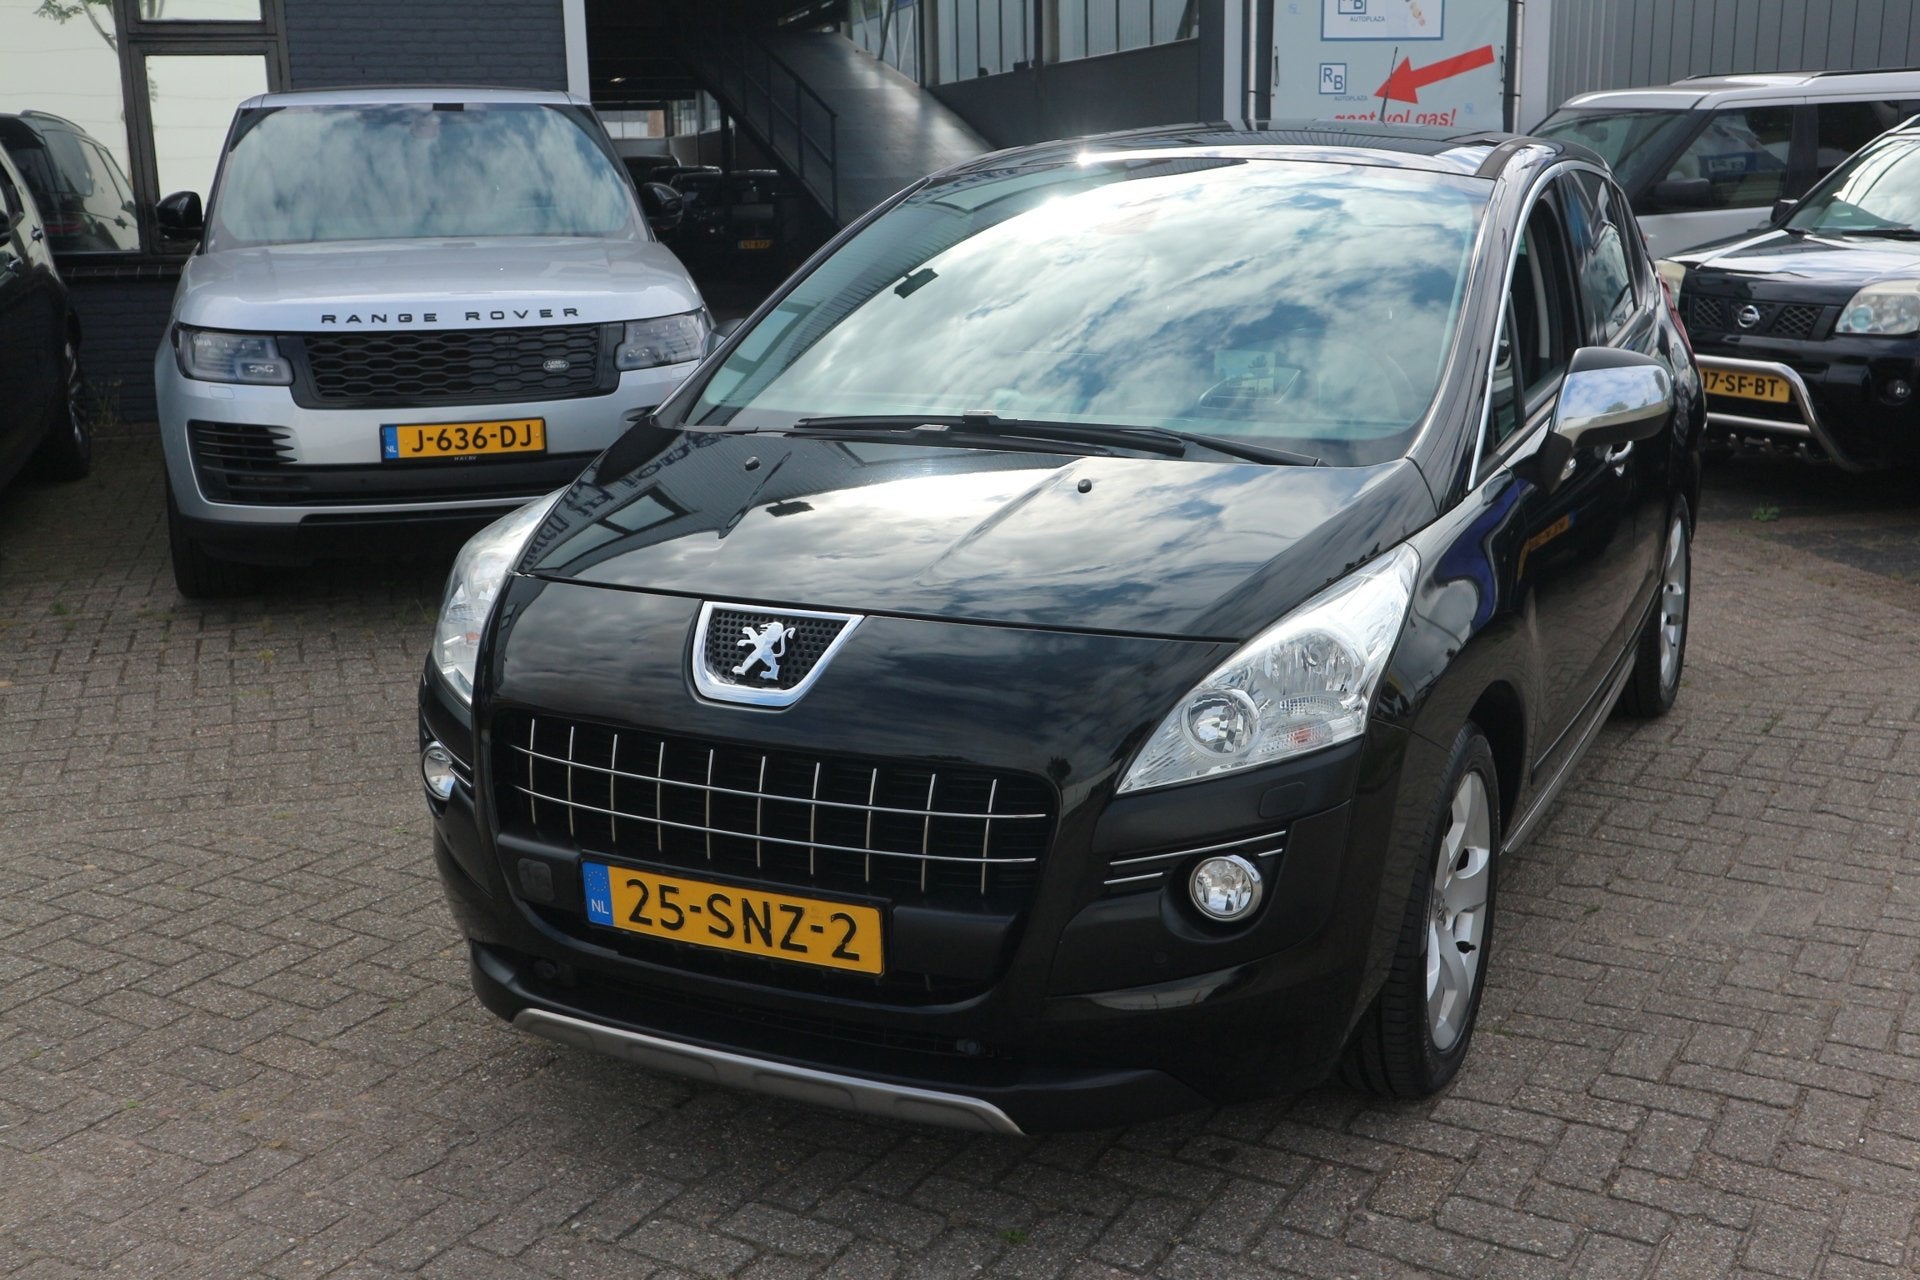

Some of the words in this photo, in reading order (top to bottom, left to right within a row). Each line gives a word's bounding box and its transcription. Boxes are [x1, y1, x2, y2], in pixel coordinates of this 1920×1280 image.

[1415, 108, 1457, 127] gas!
[321, 313, 438, 324] RANGE
[465, 307, 579, 321] ROVER
[1703, 372, 1779, 397] 17-SF-BT
[386, 445, 396, 453] NL
[411, 424, 533, 453] J-636-DJ
[591, 899, 609, 915] NL
[626, 878, 860, 961] 25-SNZ-2
